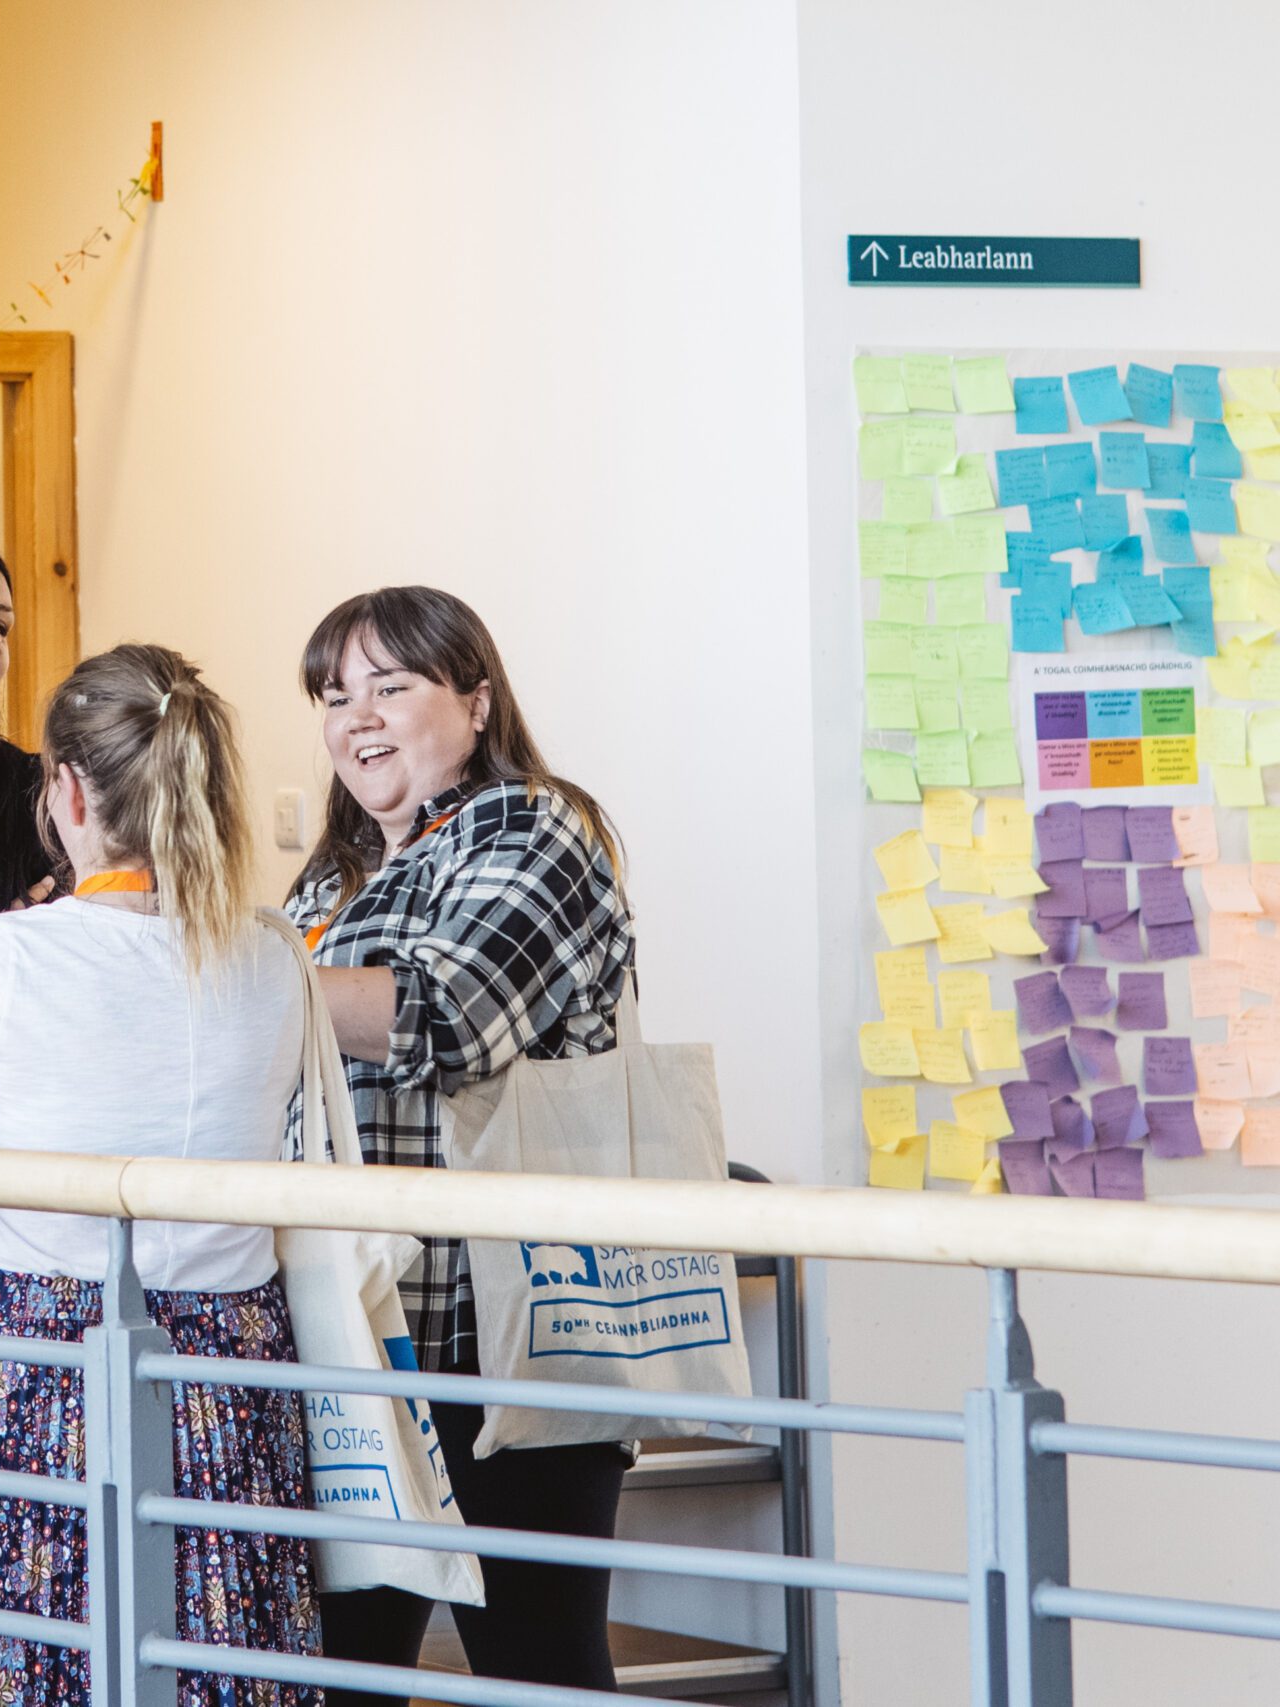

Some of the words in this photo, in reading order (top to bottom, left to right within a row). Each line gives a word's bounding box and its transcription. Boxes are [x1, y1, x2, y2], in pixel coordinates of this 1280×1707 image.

[898, 245, 1034, 270] Leabharlann
[1043, 666, 1072, 675] TOGAIL
[651, 1254, 720, 1281] OSTAIG
[323, 1427, 384, 1451] OSTAIG
